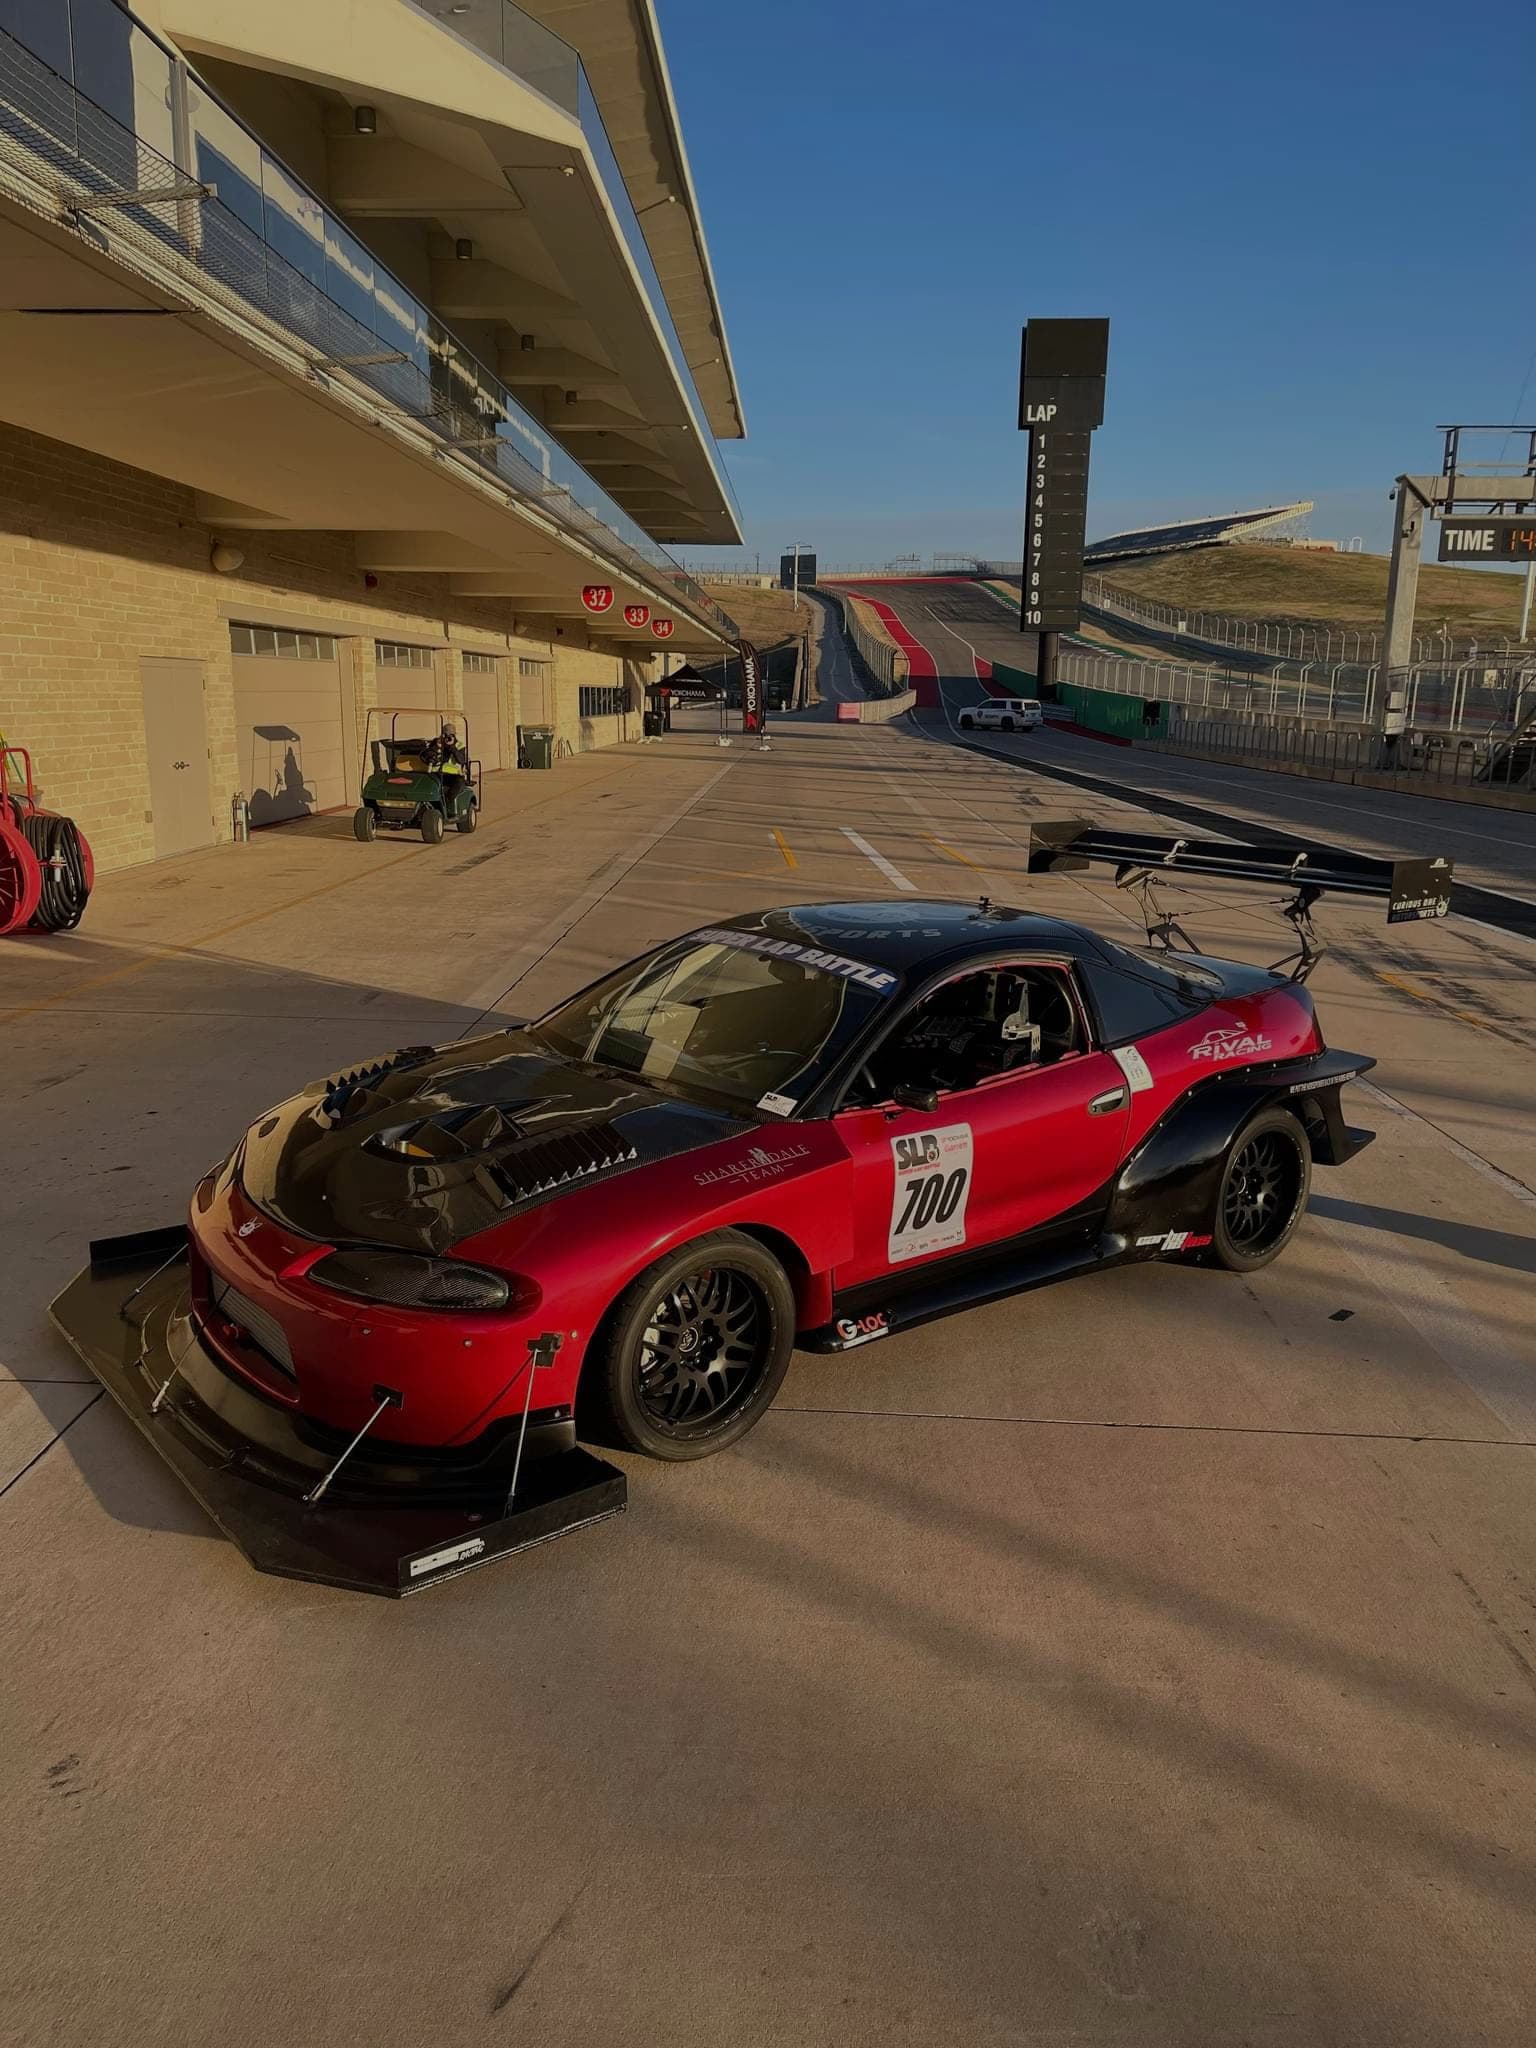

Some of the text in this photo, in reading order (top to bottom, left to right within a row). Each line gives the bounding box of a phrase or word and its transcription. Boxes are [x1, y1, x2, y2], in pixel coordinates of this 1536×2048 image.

[1027, 404, 1057, 422] LAP
[1039, 433, 1046, 449] 1
[1037, 454, 1046, 469] 2
[1036, 474, 1045, 489] 3
[1034, 494, 1044, 508] 4
[1034, 513, 1043, 528] 5
[1033, 533, 1042, 547] 6
[1445, 529, 1496, 551] TIME
[1032, 552, 1041, 567] 7
[1031, 572, 1040, 586] 8
[589, 588, 607, 607] 32
[1030, 591, 1039, 605] 9
[630, 608, 644, 623] 33
[1025, 610, 1042, 625] 10
[656, 621, 669, 634] 34
[744, 656, 757, 712] YOKOHAMA
[670, 689, 706, 697] YOKOHAMA
[689, 929, 899, 989] SUPER LAP BATTLE
[1192, 1034, 1271, 1061] RIVAL
[1219, 1041, 1272, 1060] RACING
[739, 1164, 785, 1183] TEAM
[894, 1168, 967, 1236] 700
